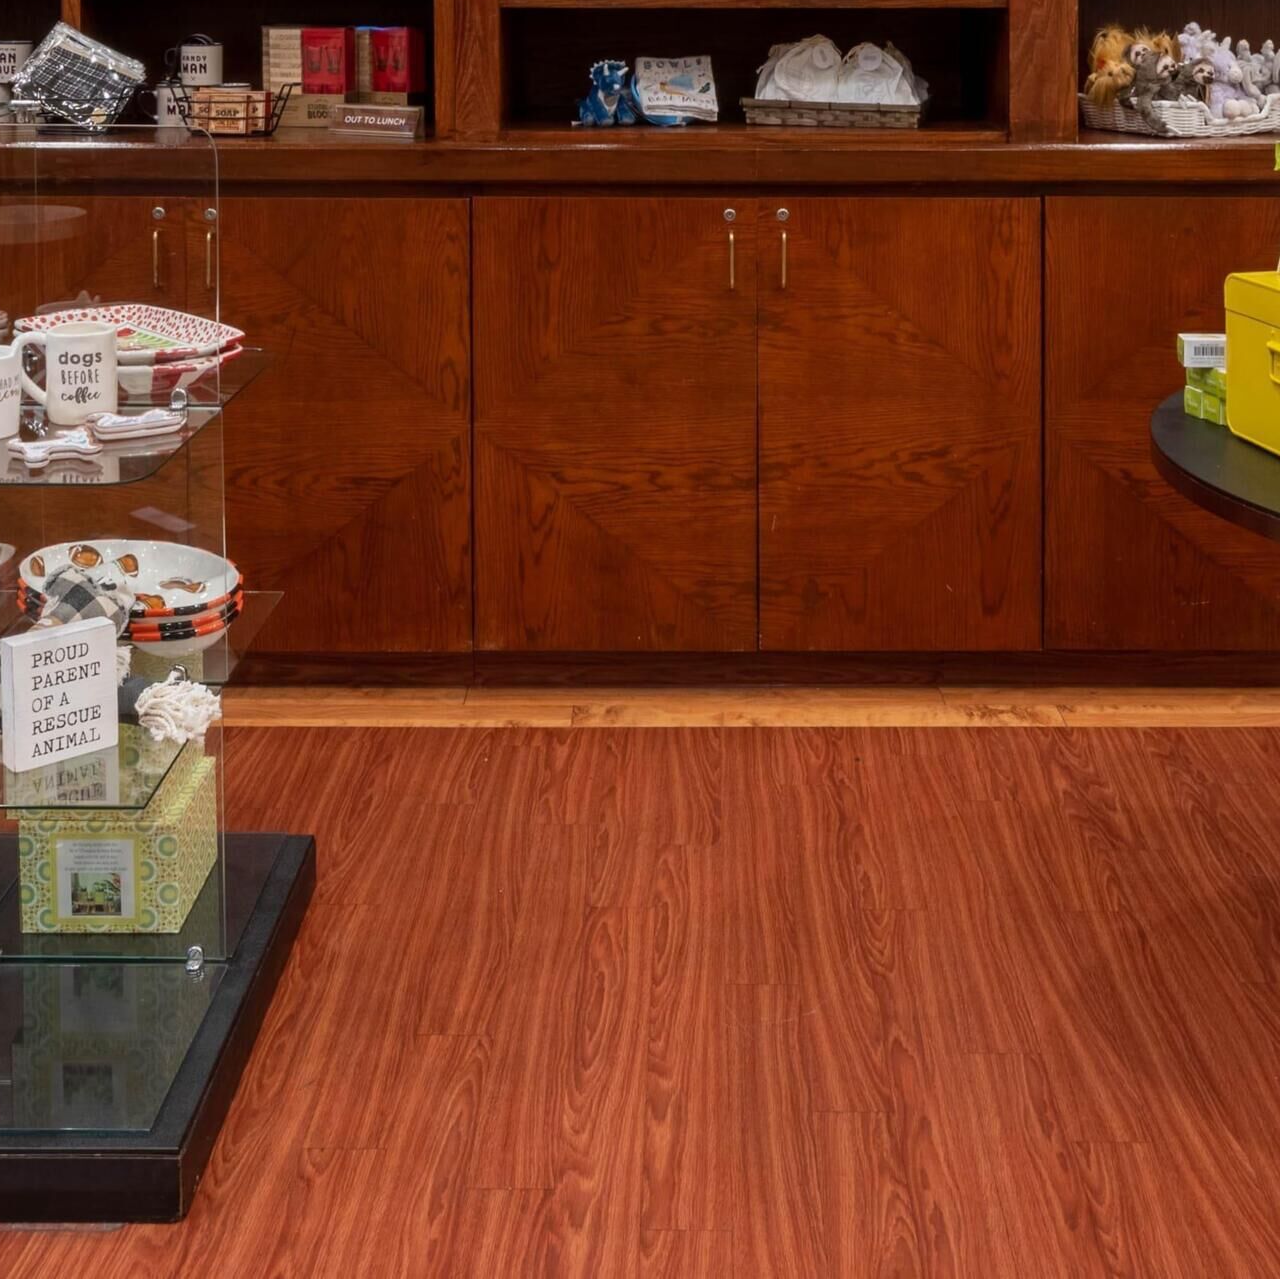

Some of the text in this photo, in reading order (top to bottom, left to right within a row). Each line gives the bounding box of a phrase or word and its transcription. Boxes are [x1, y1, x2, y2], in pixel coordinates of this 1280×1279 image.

[344, 115, 406, 126] OUT TO LUNCH
[58, 352, 103, 367] dogs
[0, 378, 13, 391] HAD
[60, 369, 100, 385] BEFORE
[60, 387, 102, 405] coffee
[32, 642, 90, 668] PROUD
[32, 661, 101, 691] PARENT
[32, 692, 70, 713] OF A
[32, 705, 102, 736] RESCUE
[32, 728, 101, 758] ANIMAL
